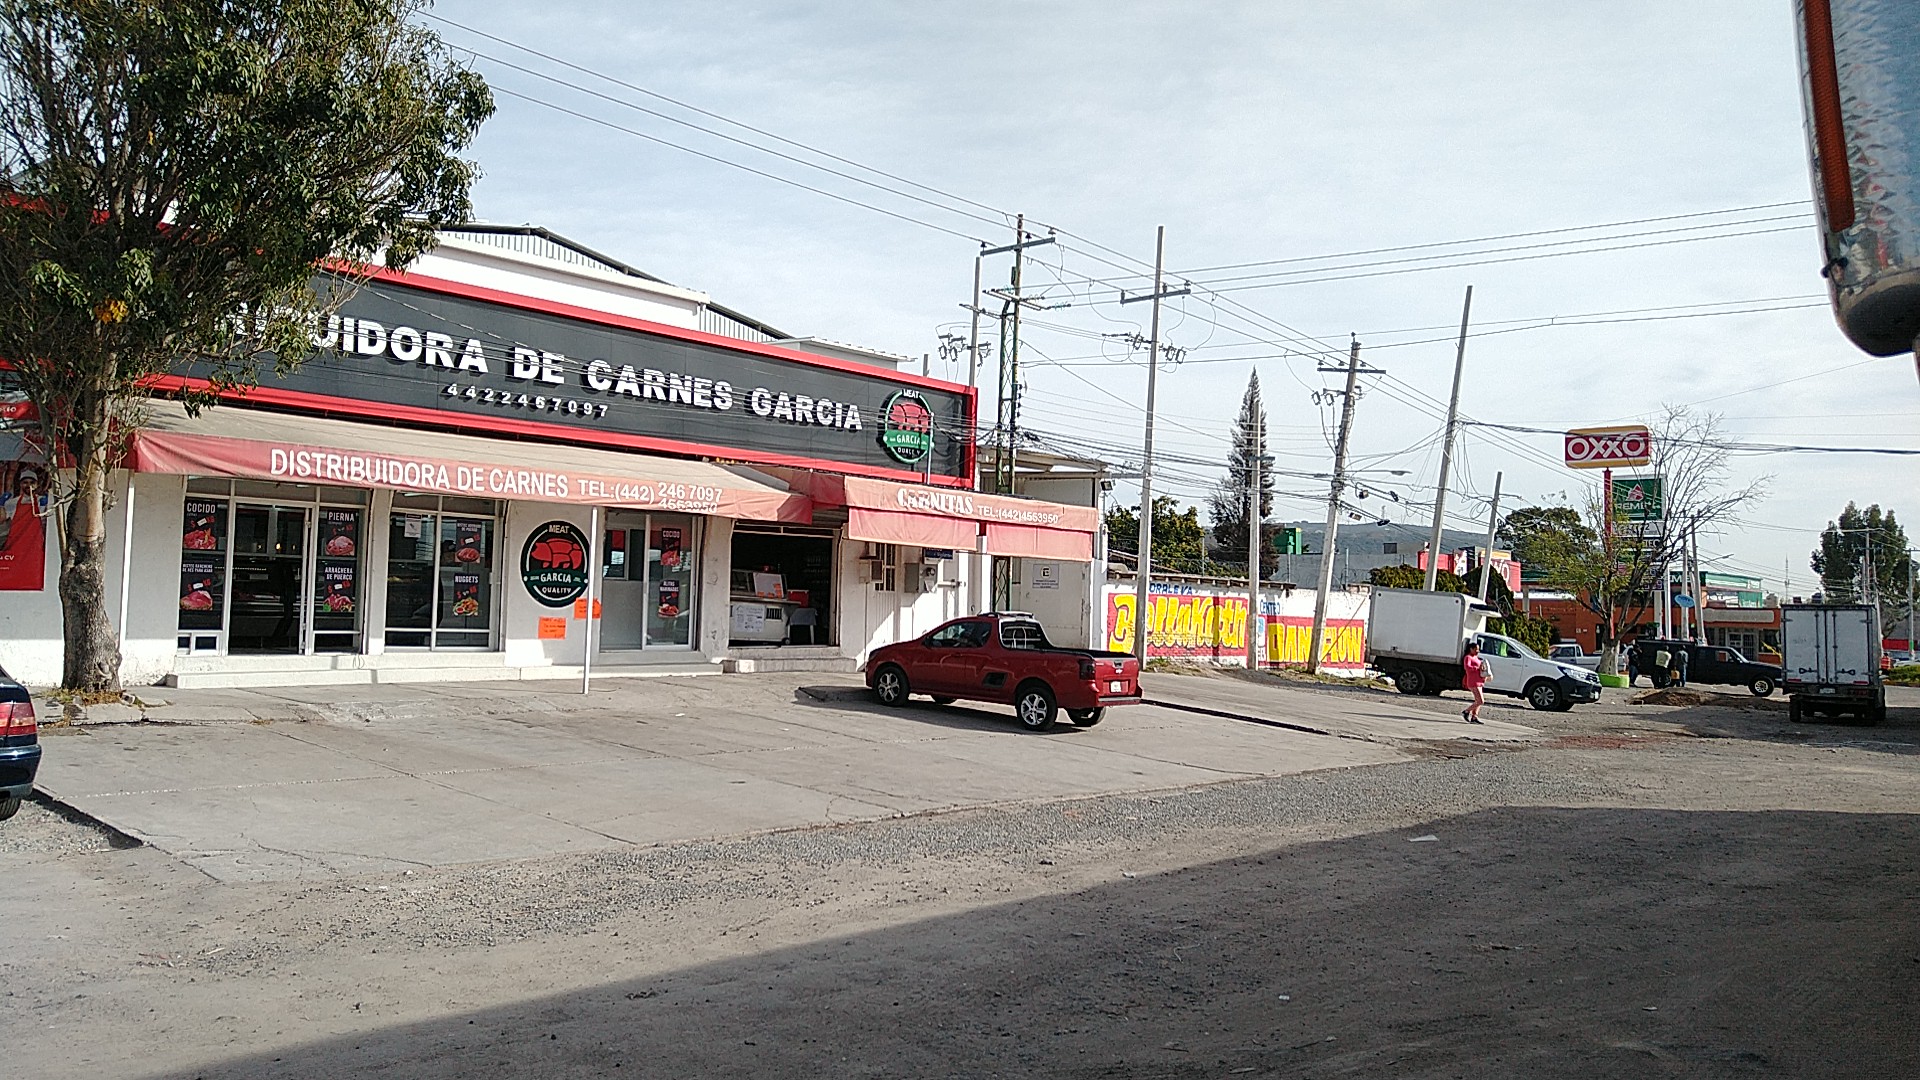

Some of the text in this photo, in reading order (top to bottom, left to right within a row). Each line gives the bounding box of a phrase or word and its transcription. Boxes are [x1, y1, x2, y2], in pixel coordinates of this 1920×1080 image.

[513, 345, 565, 384] DE
[587, 359, 733, 411] CARNES
[750, 387, 863, 431] GARCIA
[903, 388, 919, 399] MEAT
[447, 383, 608, 417] 4422467097
[1567, 434, 1646, 461] OXXO
[270, 448, 451, 490] DISTRIBUIDORA
[457, 466, 485, 493] DE
[489, 468, 569, 498] CARNES
[897, 488, 974, 516] CARNITAS
[187, 502, 216, 514] COCIDO
[328, 511, 355, 522] PIERNA
[548, 524, 570, 534] MEAT
[662, 530, 680, 538] COCIDO
[325, 566, 353, 574] ARRACHERA
[455, 575, 479, 583] NUGGETS
[540, 572, 571, 583] GARCIA
[541, 586, 572, 594] QUALITY
